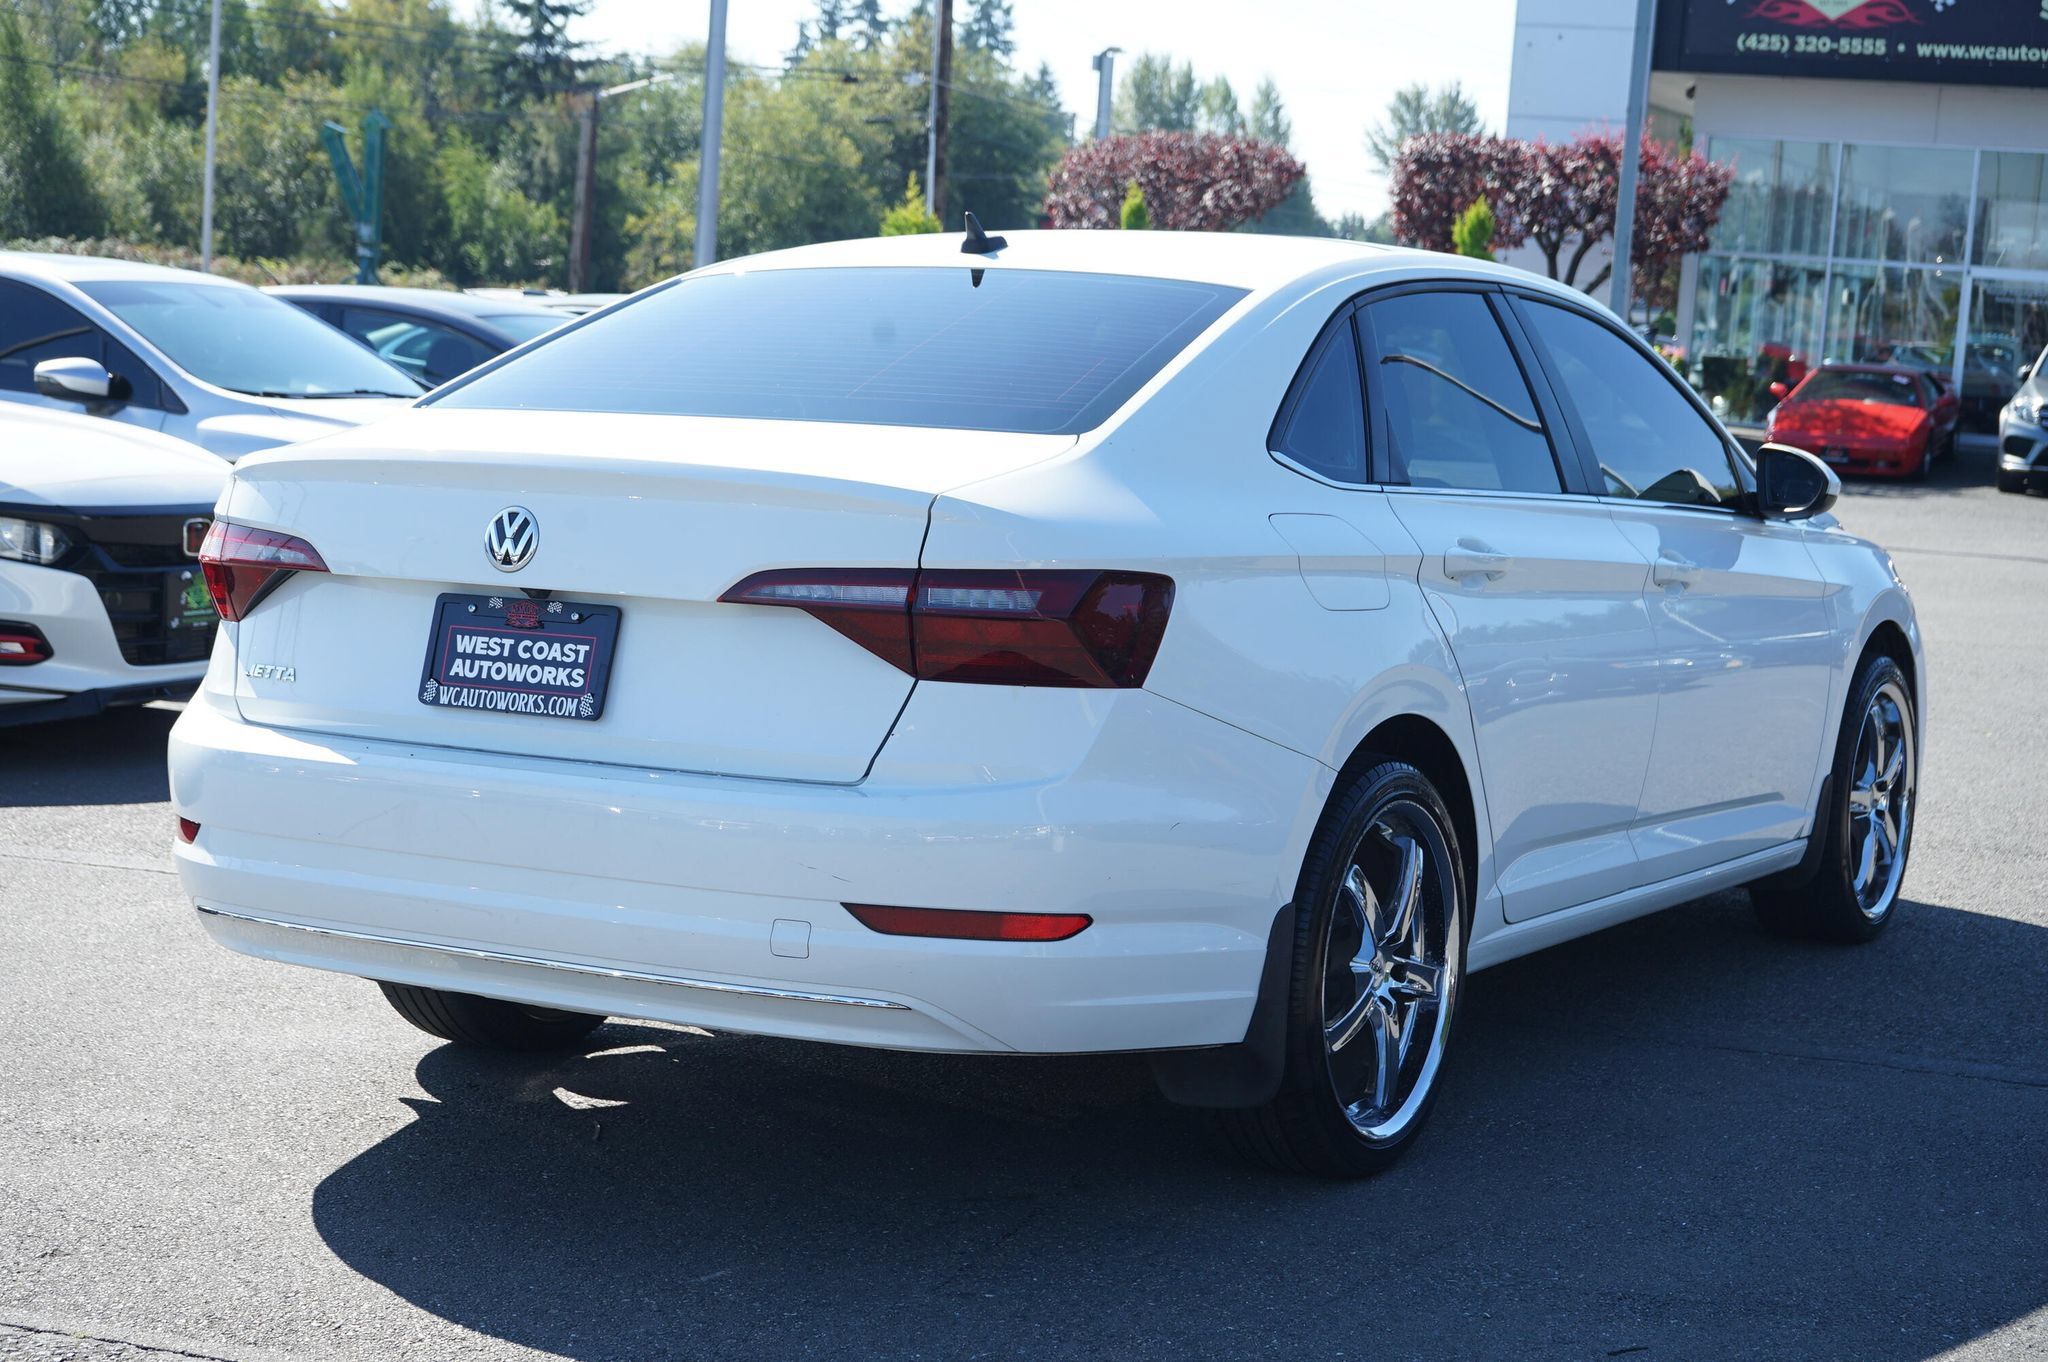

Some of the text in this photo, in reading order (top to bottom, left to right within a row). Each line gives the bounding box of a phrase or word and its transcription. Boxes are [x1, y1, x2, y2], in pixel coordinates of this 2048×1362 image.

[1737, 33, 1790, 53] (425)
[1794, 35, 1887, 55] 320-5555
[456, 634, 590, 663] WEST COAST
[246, 664, 296, 683] JETTA
[449, 658, 585, 688] AUTOWORKS
[439, 685, 578, 717] WCAUTOWORKS.COM
